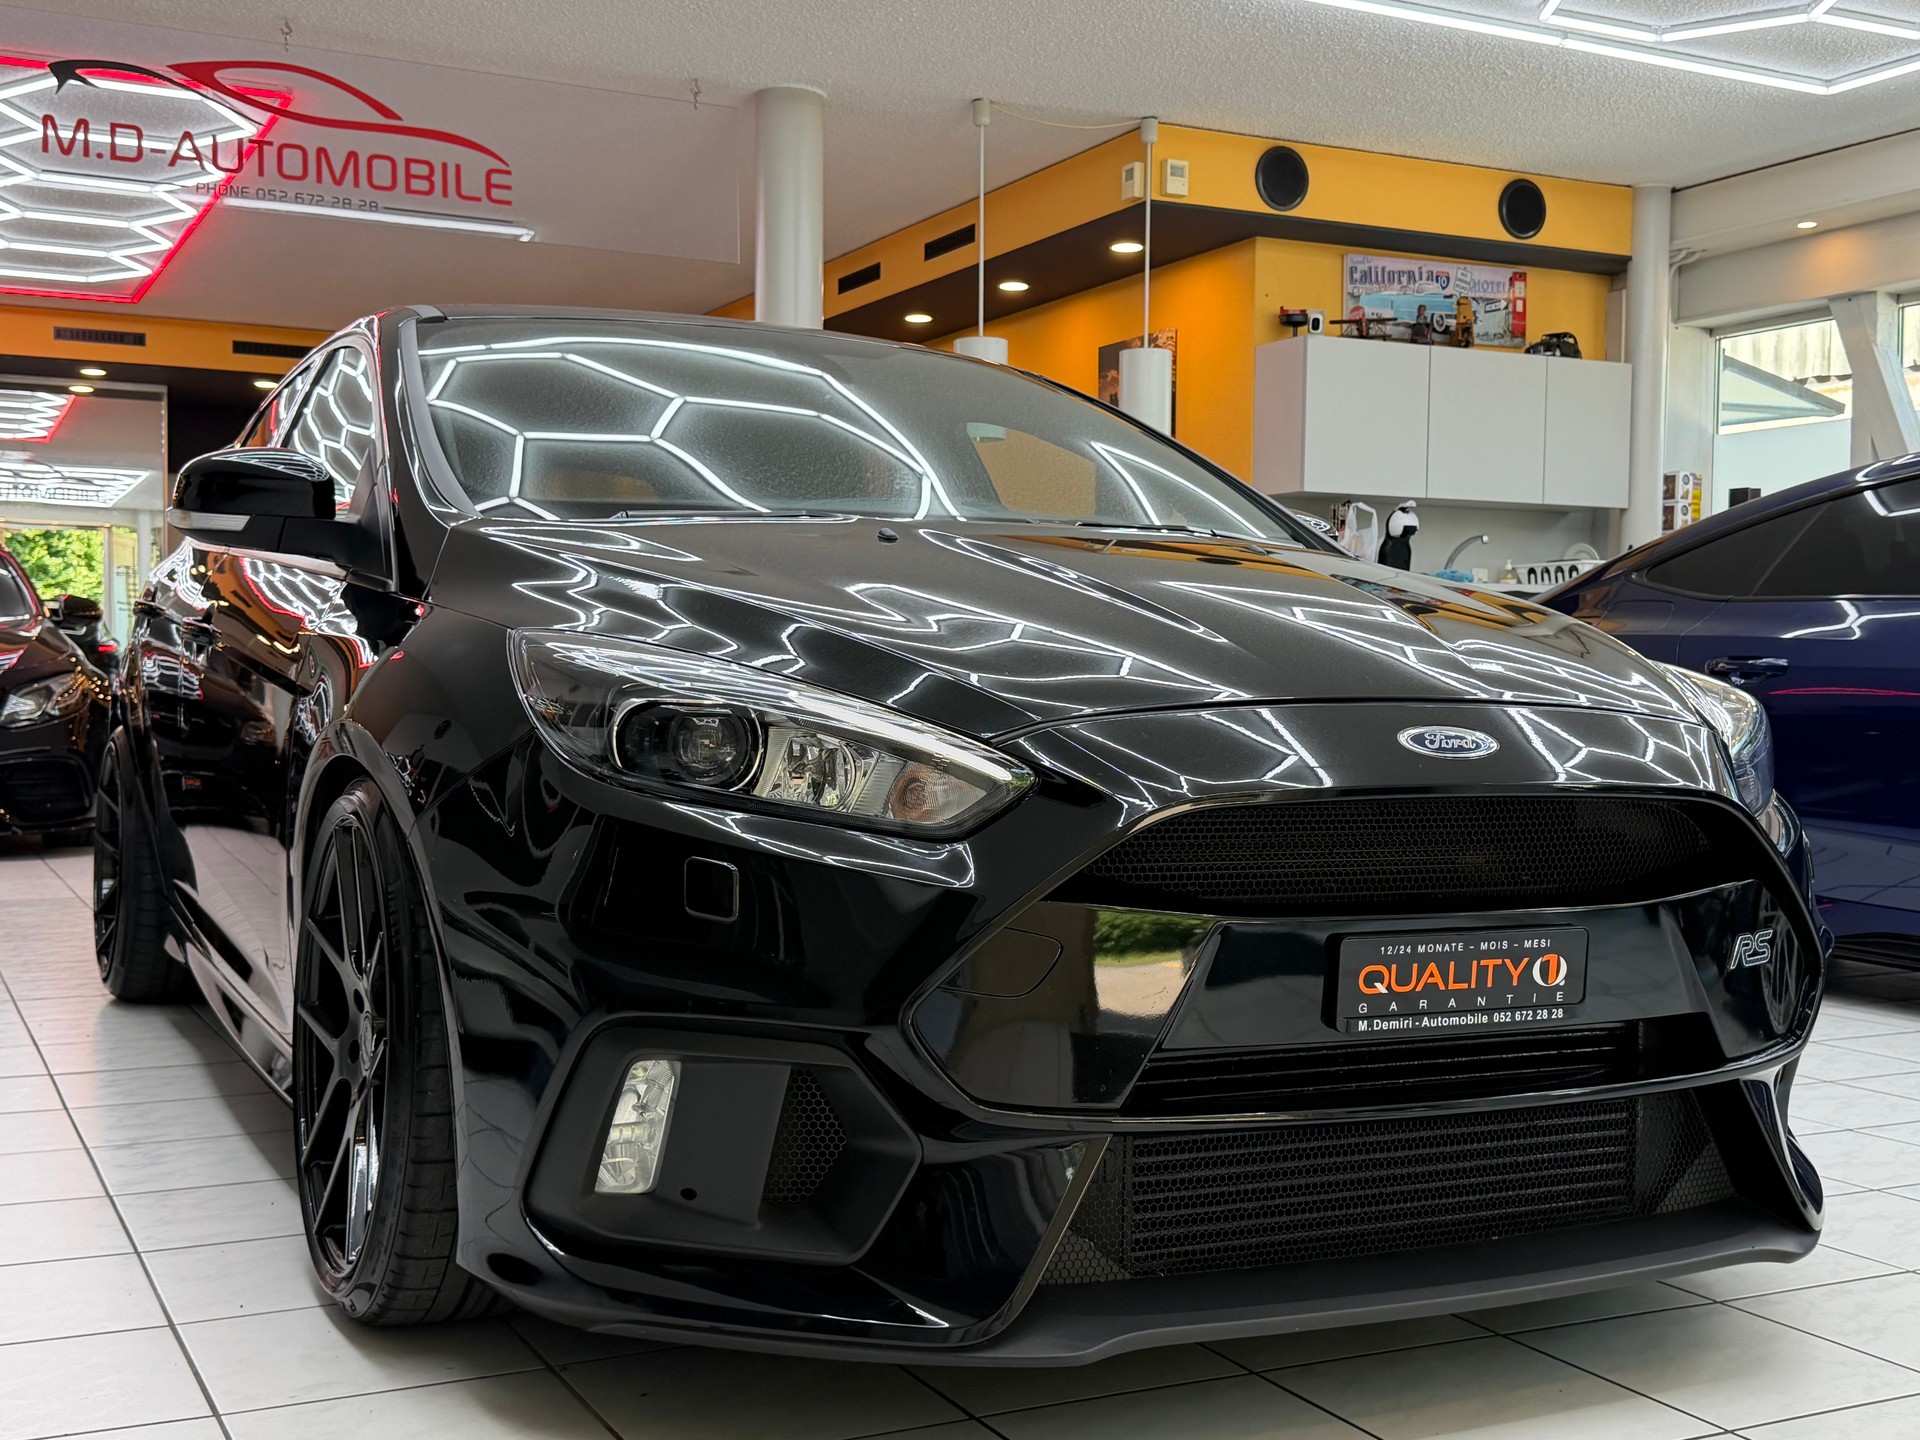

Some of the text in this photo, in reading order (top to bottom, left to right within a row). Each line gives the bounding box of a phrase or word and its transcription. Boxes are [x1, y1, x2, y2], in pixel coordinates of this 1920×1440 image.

[195, 182, 379, 212] PHONE 052 672 28 28
[1349, 265, 1434, 285] California
[1424, 731, 1476, 749] Ford
[1380, 945, 1412, 955] 12/24
[1417, 942, 1464, 954] MONATE
[1480, 940, 1508, 951] MOIS
[1524, 939, 1551, 949] MESI
[1730, 929, 1773, 969] RS
[1358, 957, 1530, 994] QUALITY
[1358, 991, 1564, 1014] GARANTIE
[1421, 1013, 1489, 1028] Automobile
[1493, 1011, 1512, 1023] 052
[1515, 1010, 1533, 1021] 672
[1536, 1009, 1548, 1020] 28
[1551, 1008, 1564, 1019] 28
